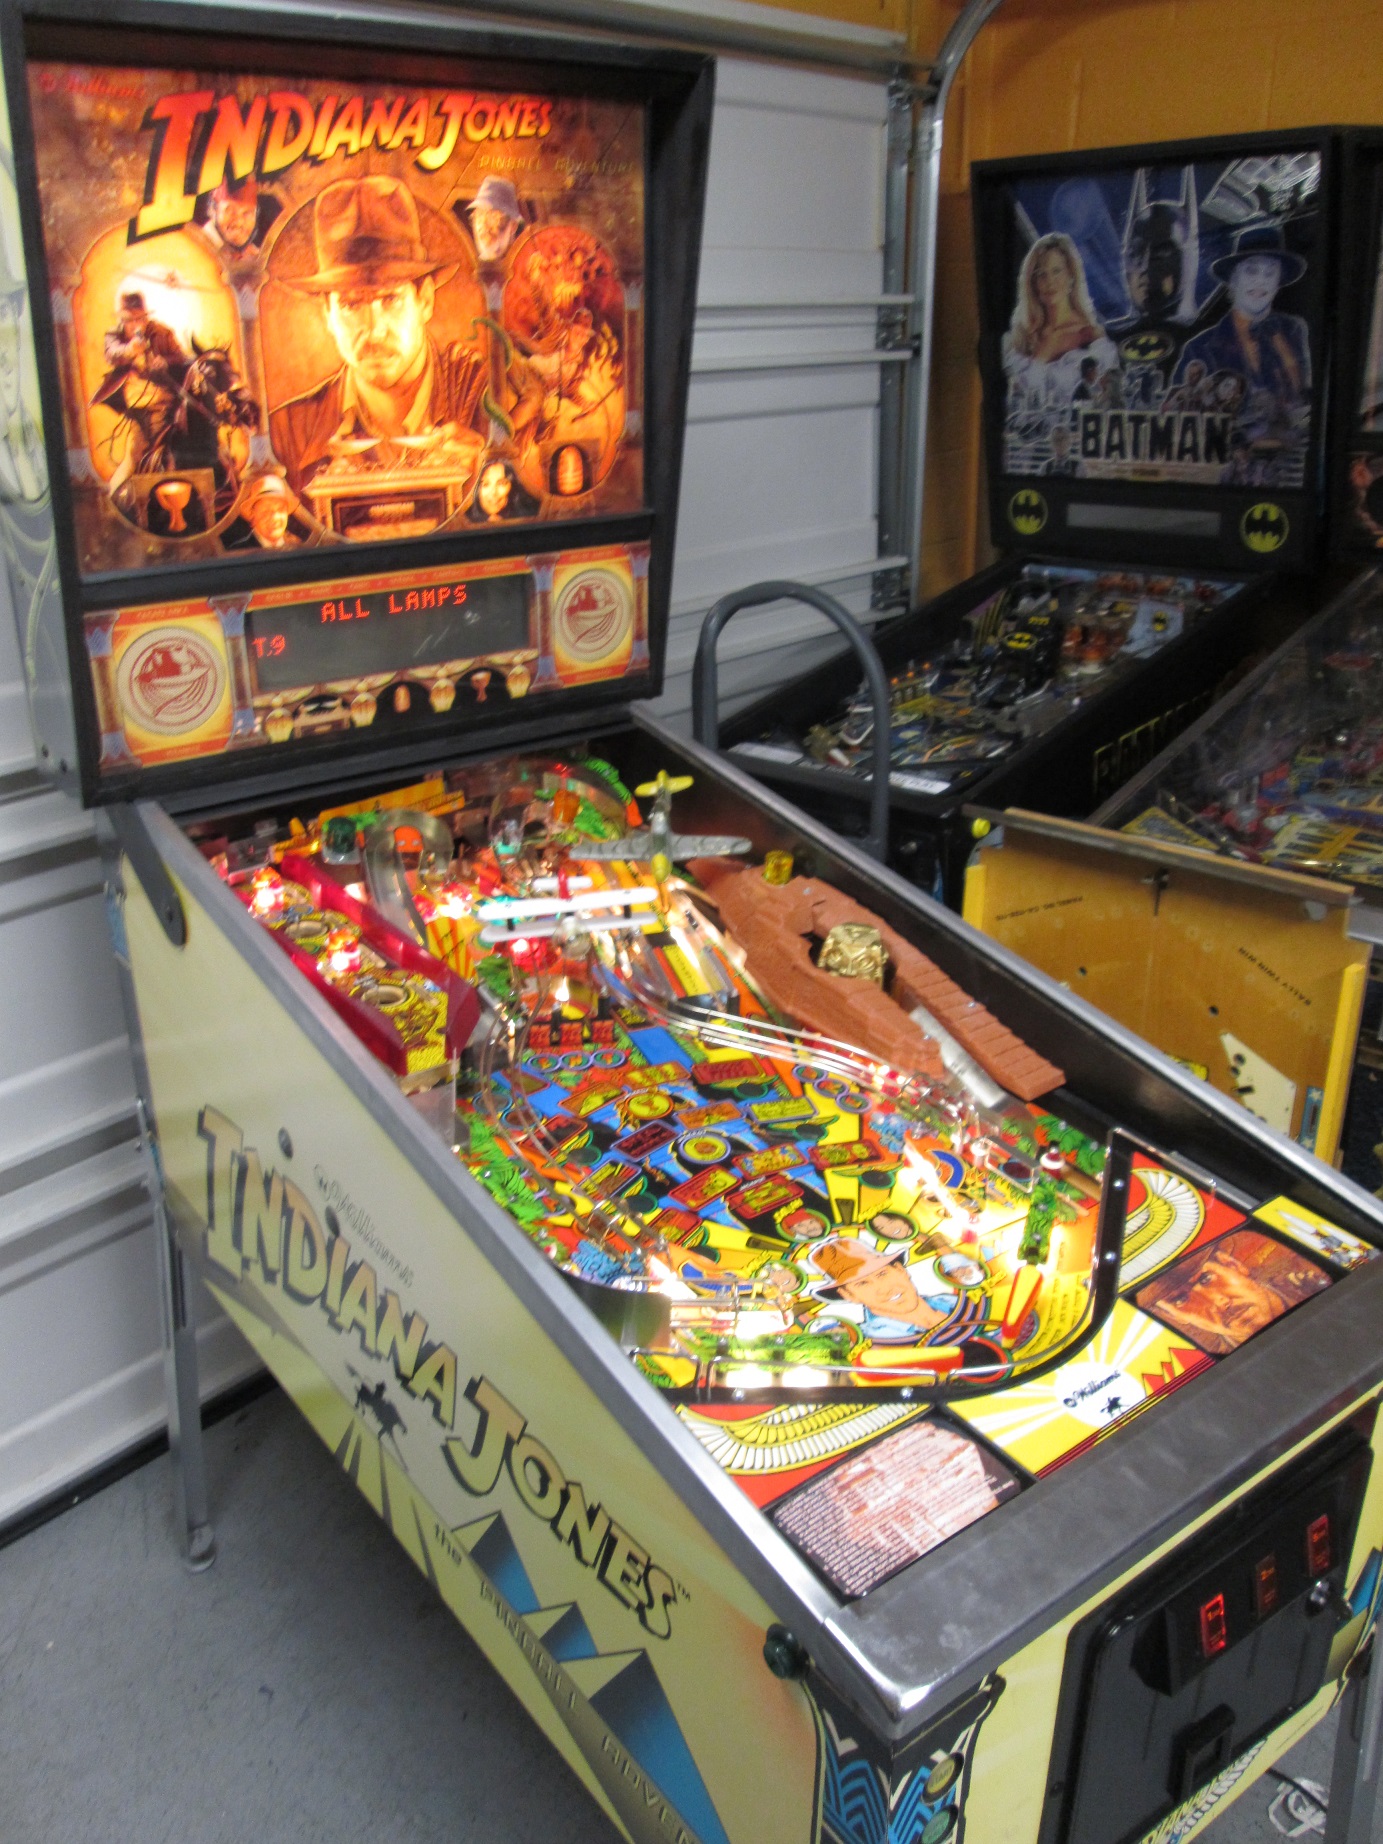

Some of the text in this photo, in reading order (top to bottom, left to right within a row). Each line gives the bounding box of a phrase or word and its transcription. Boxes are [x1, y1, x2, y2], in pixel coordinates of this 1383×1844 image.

[127, 92, 552, 244] INDIANA JONES
[1081, 412, 1231, 466] BATMAN
[320, 584, 467, 623] ALL LAMPS
[198, 1104, 458, 1430] INDIANA
[442, 1374, 677, 1640] JONES
